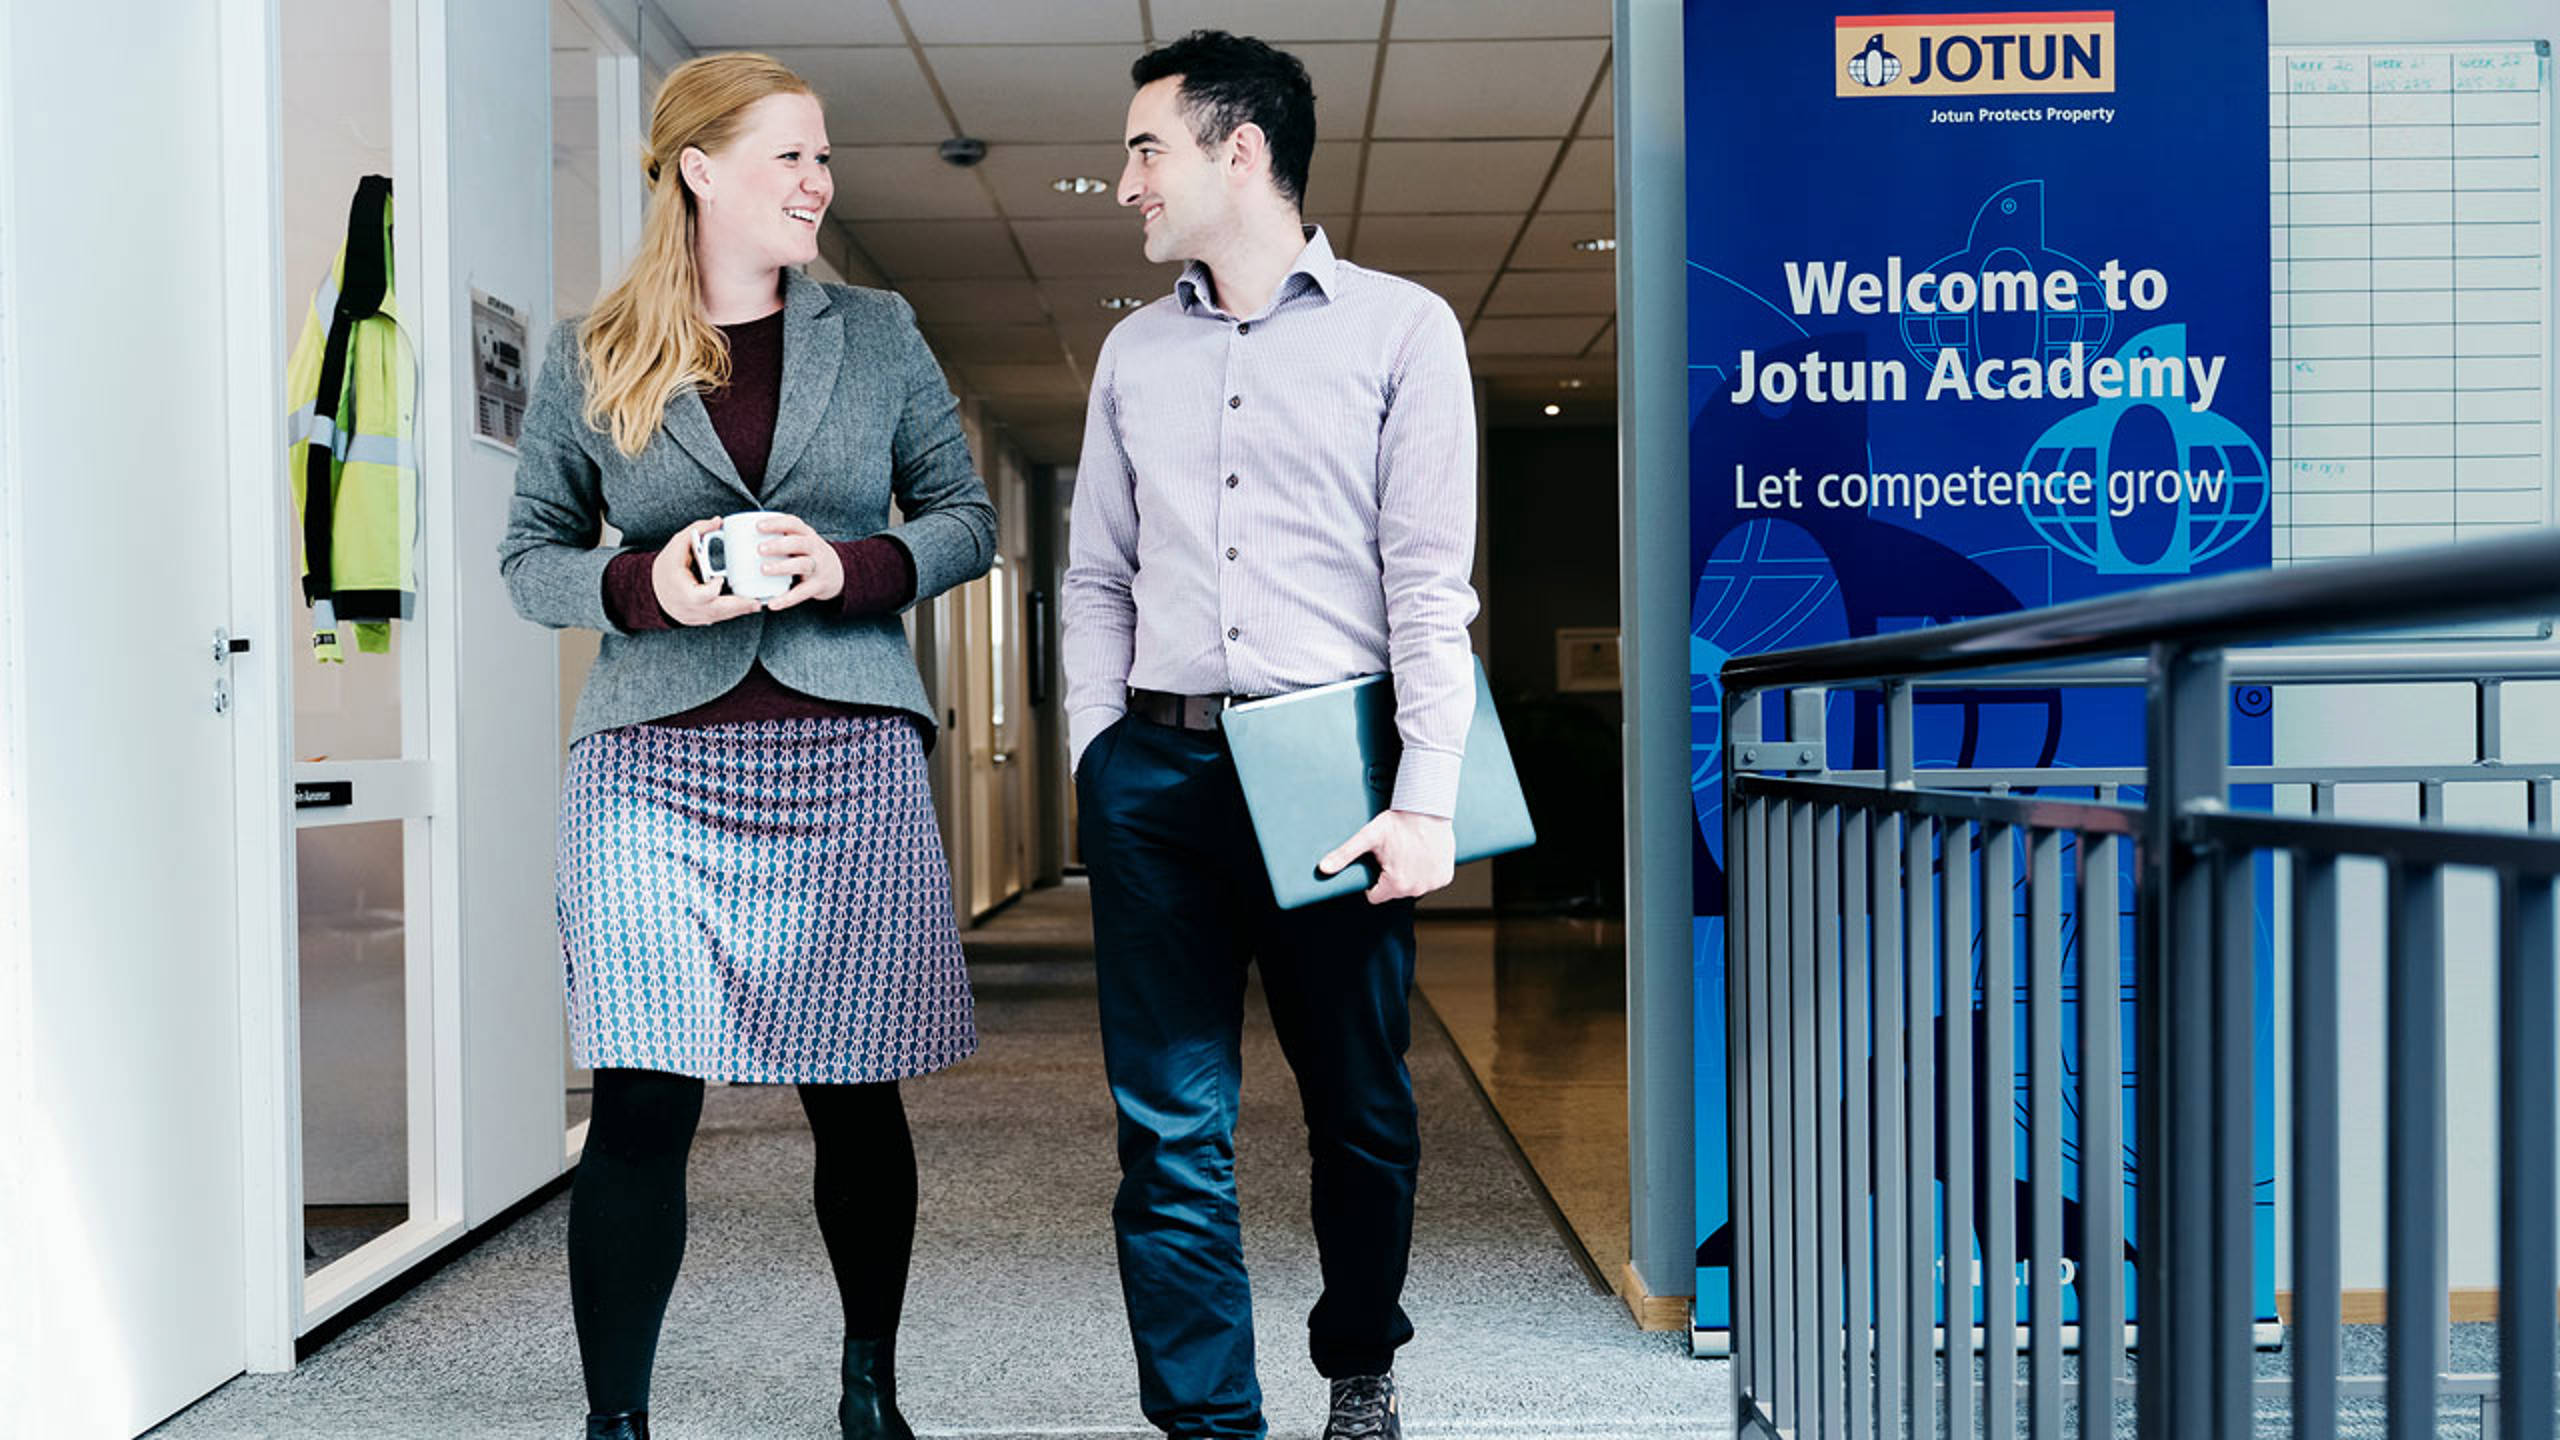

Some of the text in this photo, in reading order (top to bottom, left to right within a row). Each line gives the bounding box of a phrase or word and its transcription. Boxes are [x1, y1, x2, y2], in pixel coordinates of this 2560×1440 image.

[1909, 34, 2100, 84] JOTUN
[1931, 107, 2115, 123] Jotun Protects Property
[1785, 257, 2166, 314] Welcome to
[1732, 342, 2225, 412] Jotun Academy
[1737, 466, 2224, 518] Let competence grow
